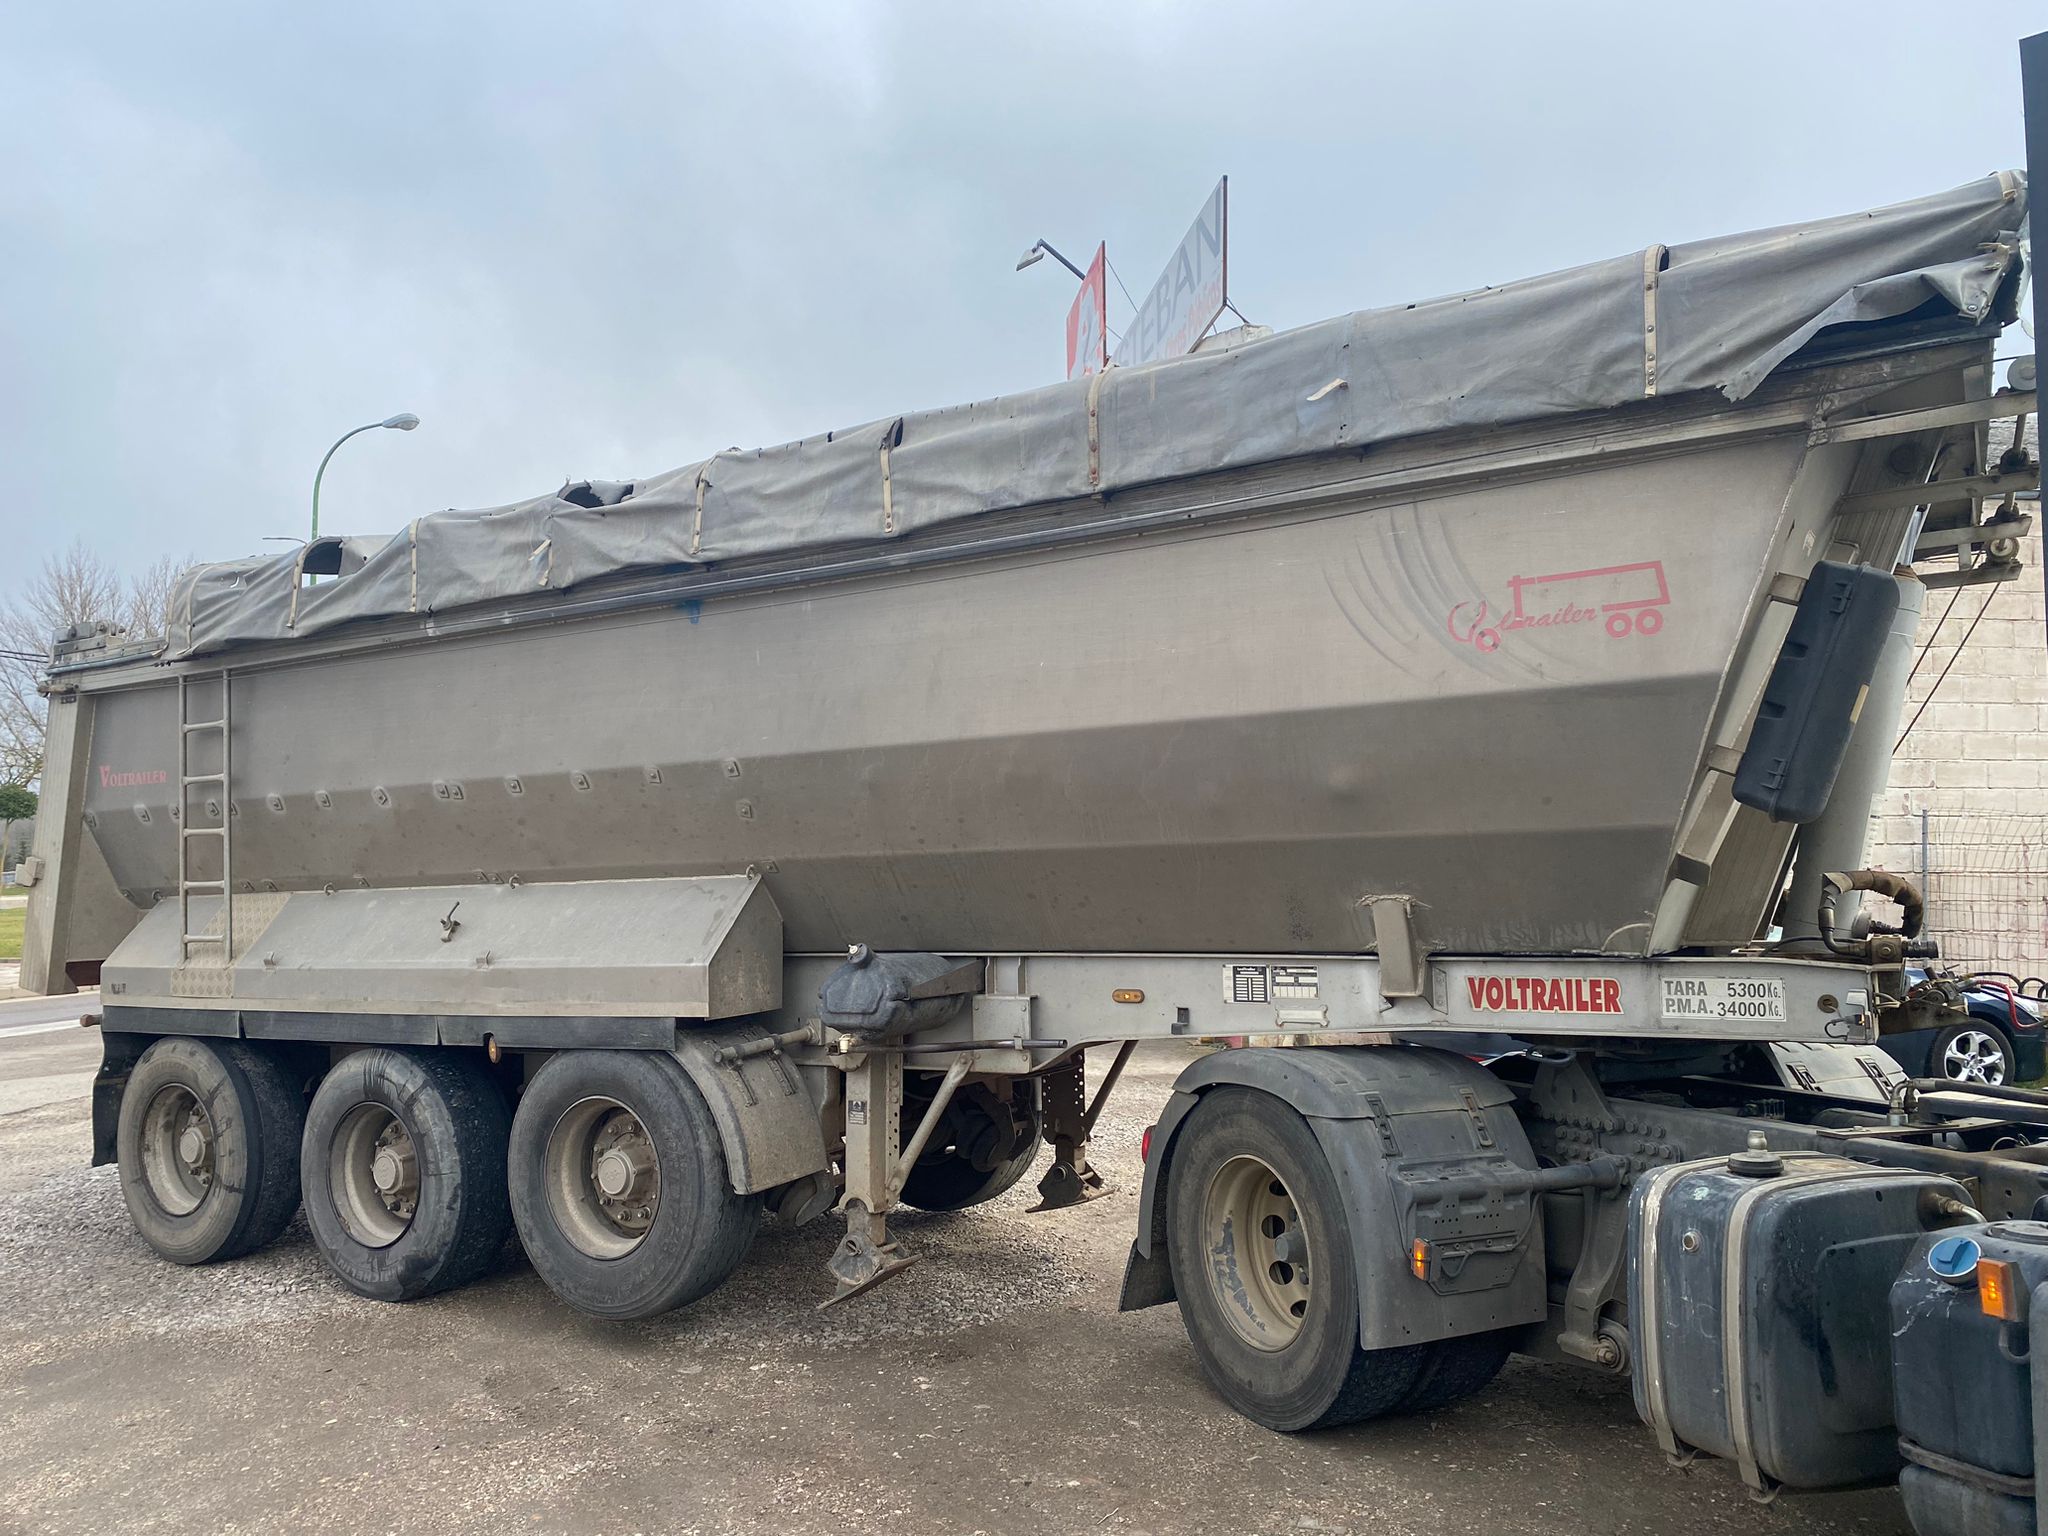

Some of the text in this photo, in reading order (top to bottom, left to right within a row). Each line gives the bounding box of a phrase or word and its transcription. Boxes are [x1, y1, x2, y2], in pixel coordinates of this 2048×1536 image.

[1467, 976, 1622, 1013] VOLTRAILER
[1664, 981, 1708, 996] TARA
[1665, 998, 1714, 1014] P.M.A.
